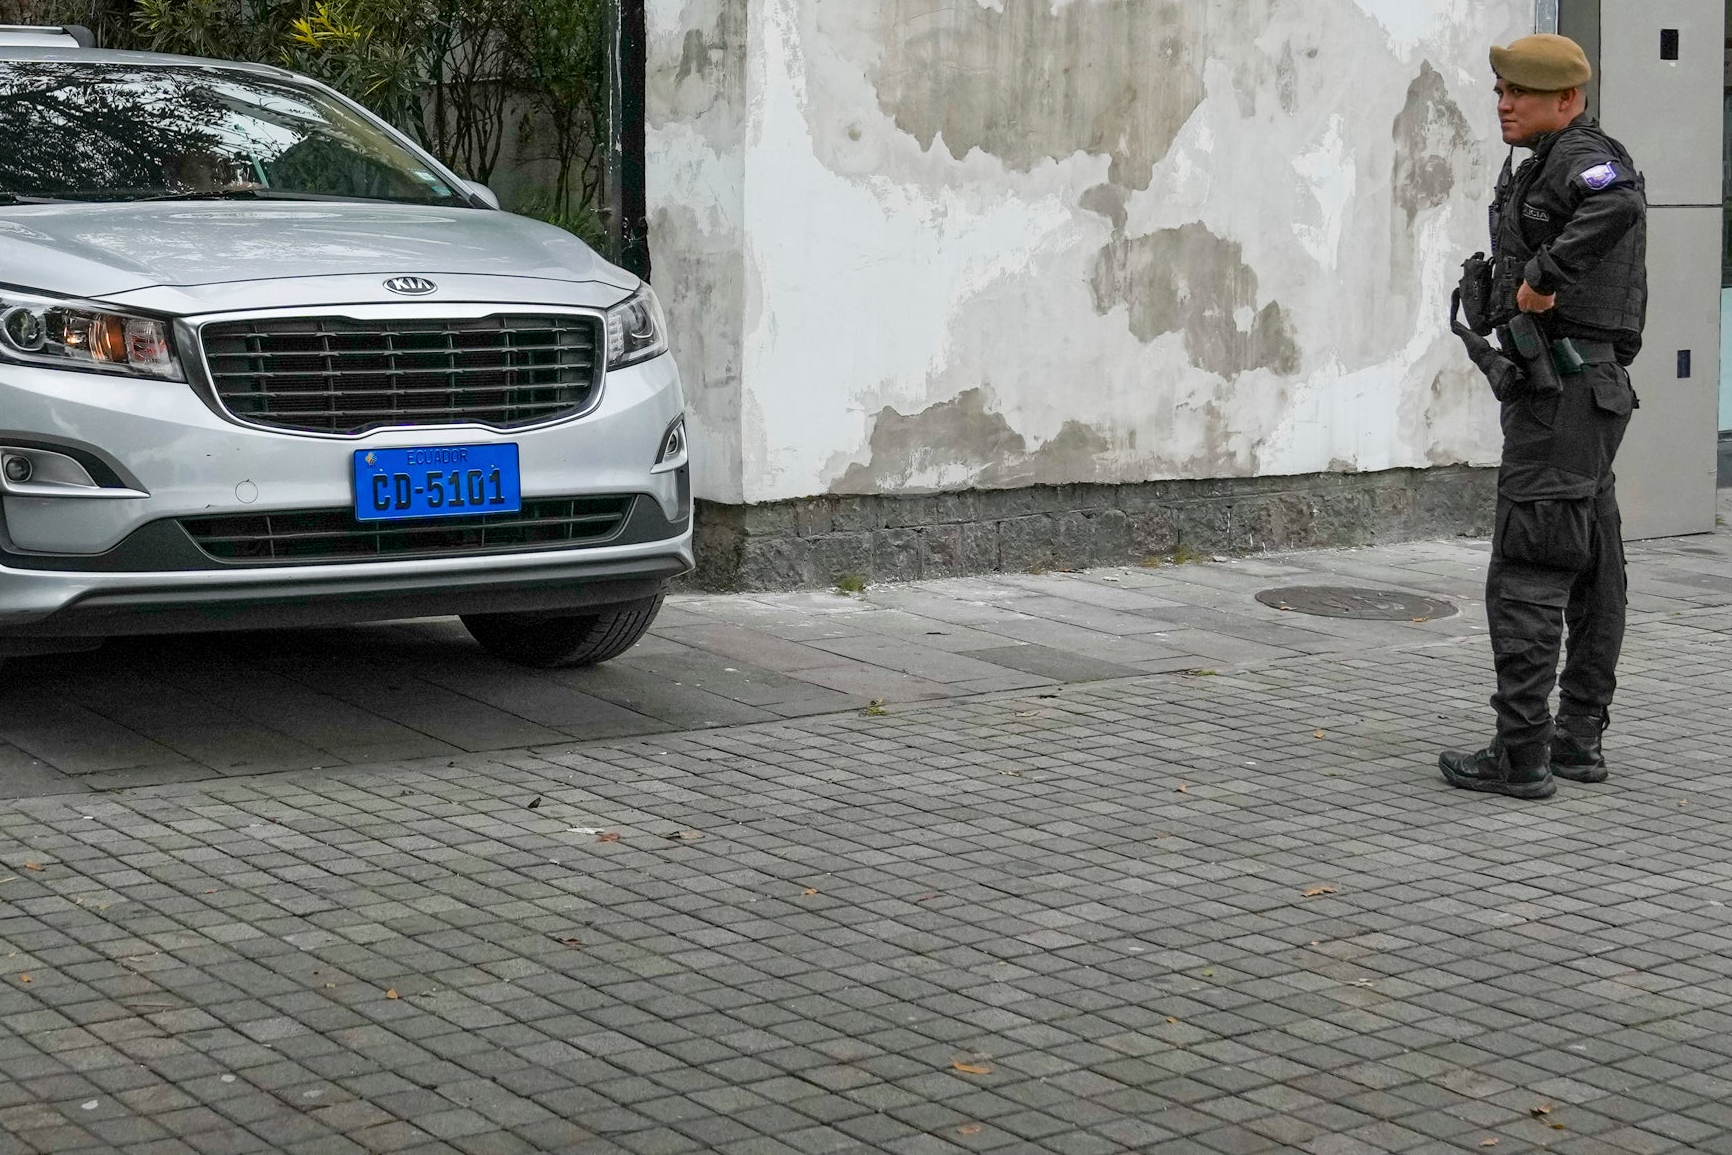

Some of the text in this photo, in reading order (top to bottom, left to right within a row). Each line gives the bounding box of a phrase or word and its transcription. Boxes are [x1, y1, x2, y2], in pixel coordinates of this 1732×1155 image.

[391, 277, 432, 290] KIA
[406, 448, 469, 466] ECUADOR
[372, 467, 505, 511] CD-5101
